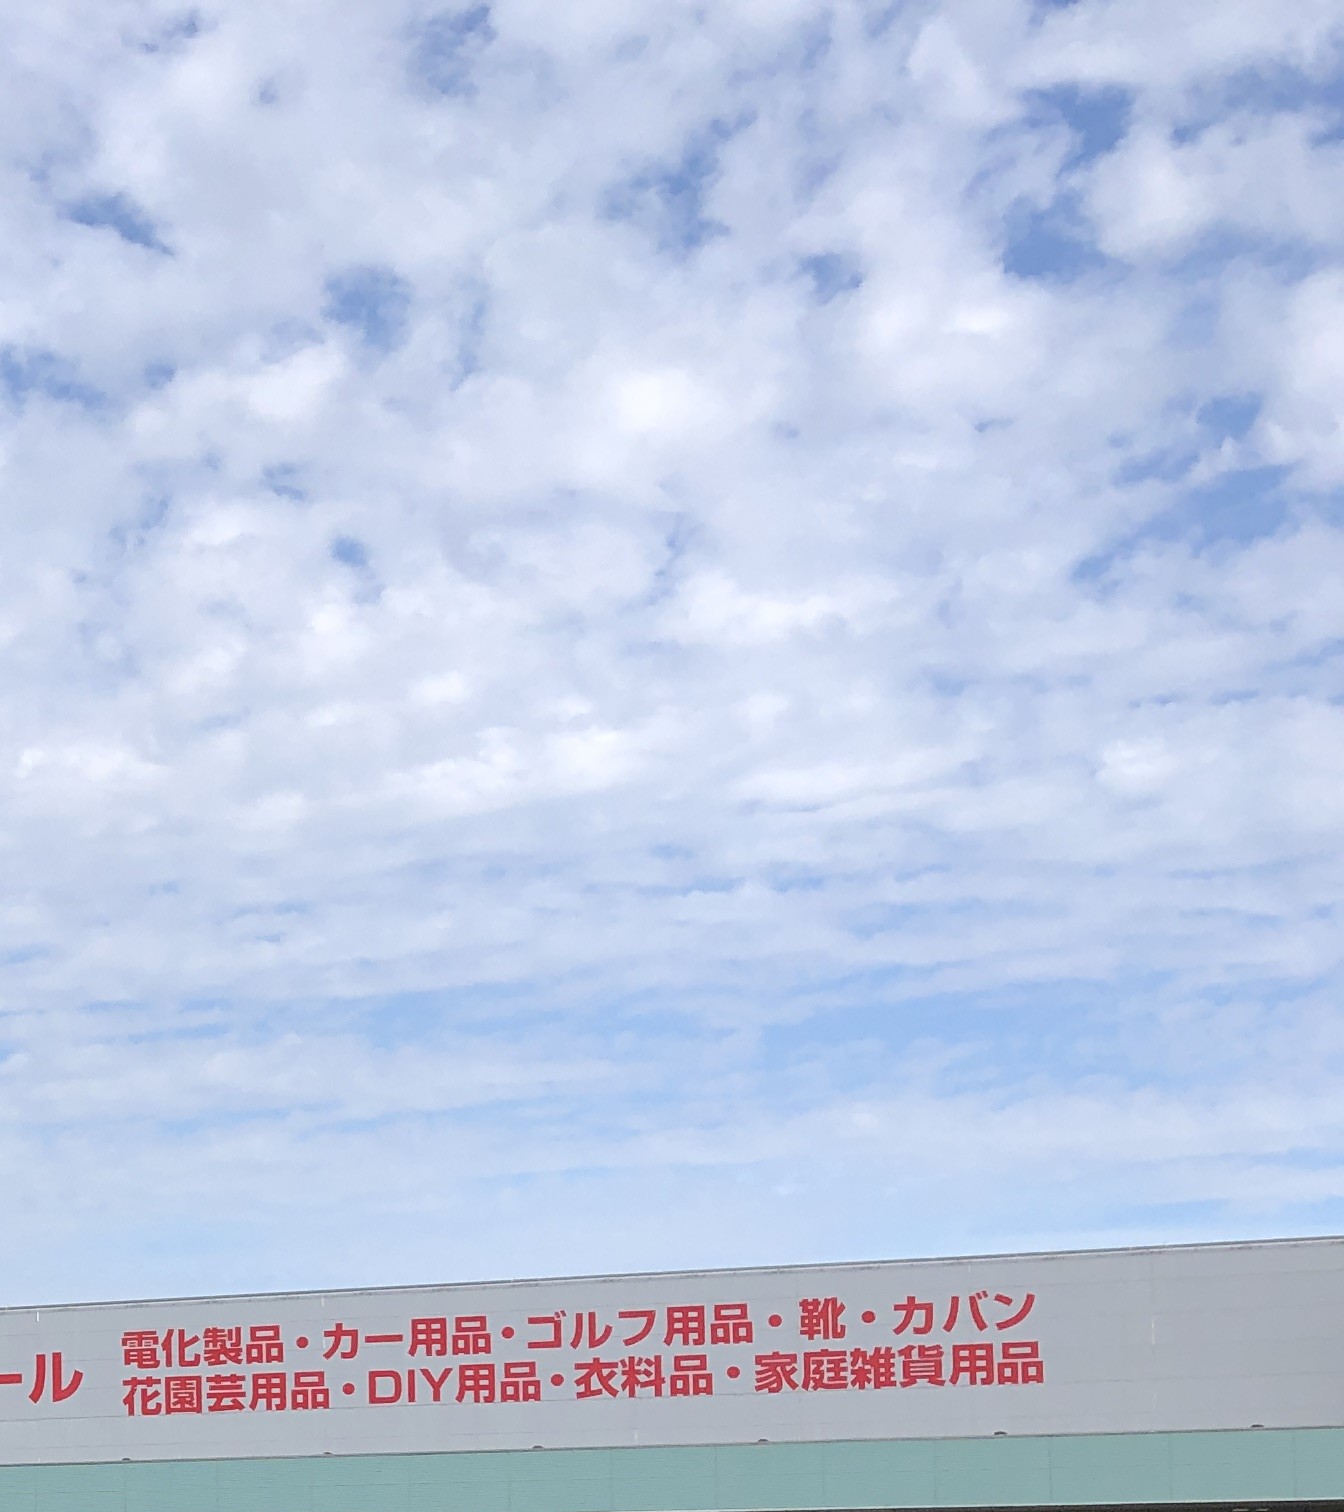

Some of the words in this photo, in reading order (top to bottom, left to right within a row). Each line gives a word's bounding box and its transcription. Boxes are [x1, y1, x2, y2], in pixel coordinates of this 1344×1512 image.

[121, 1291, 1036, 1369] 電化製品・カー用品・ゴルフ用品・靴・カバン
[122, 1341, 1045, 1417] 花園芸用品・DIY用品・衣料品・家庭雑貨用品
